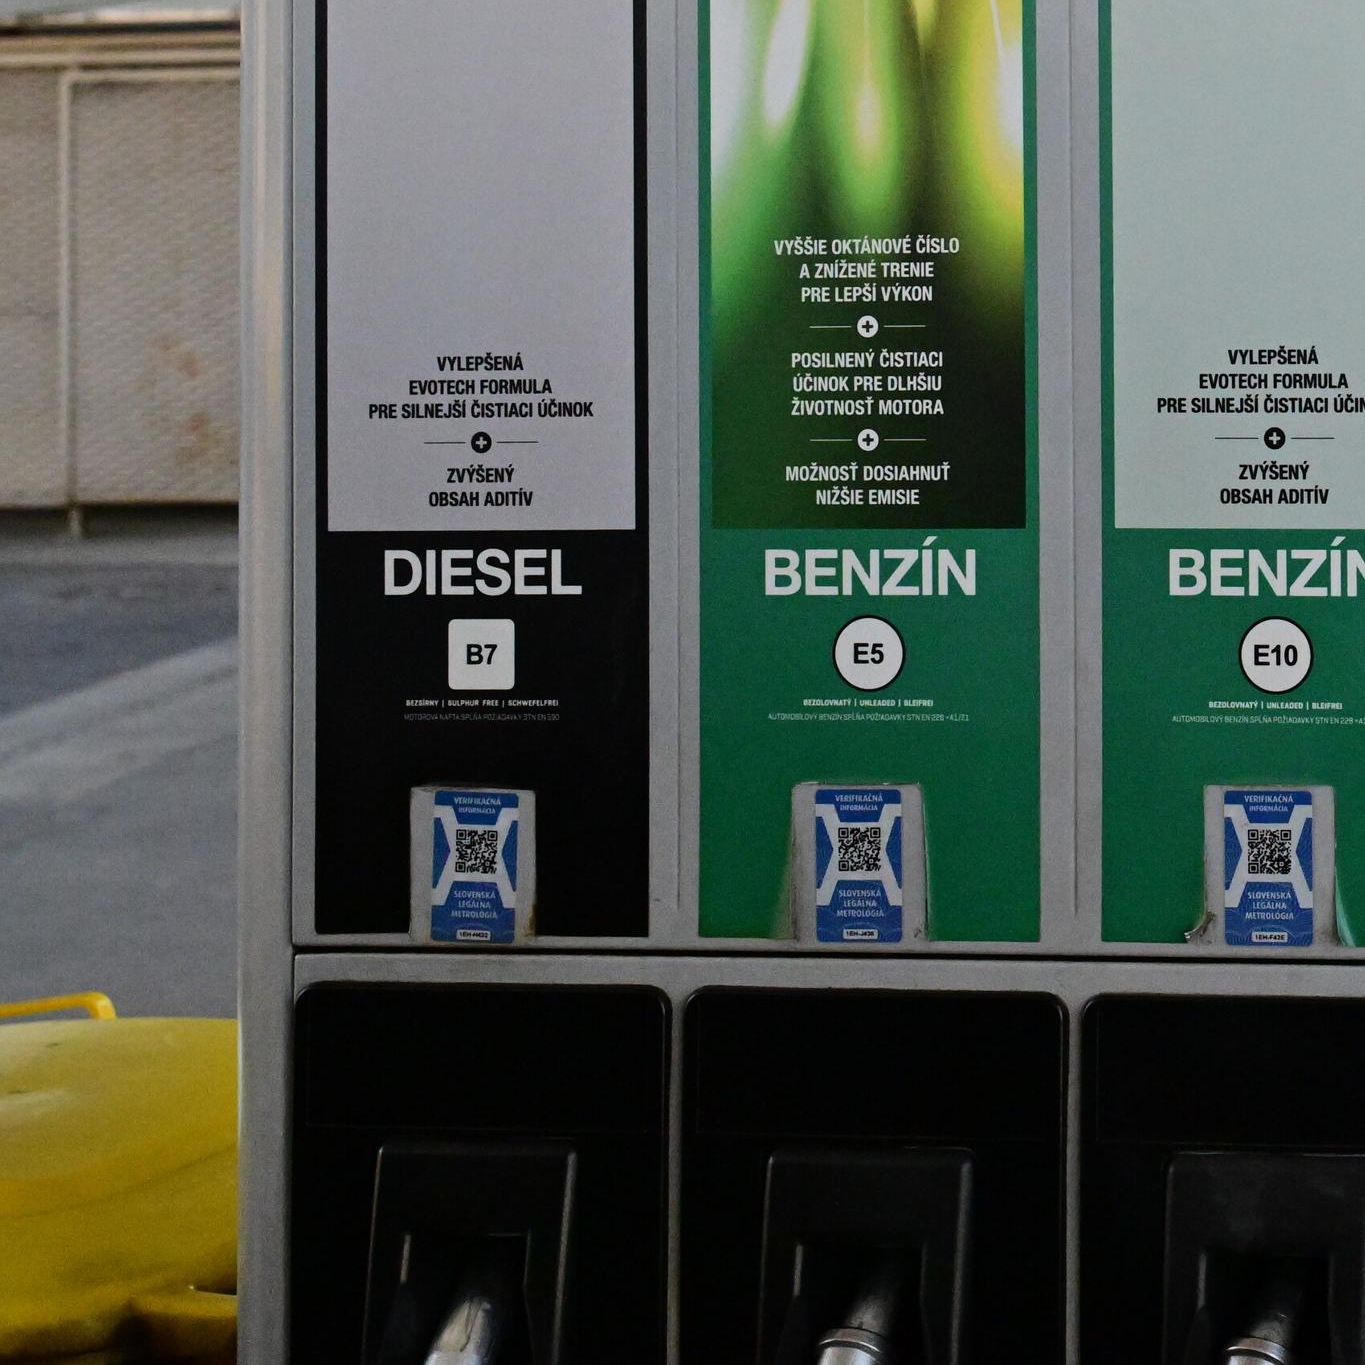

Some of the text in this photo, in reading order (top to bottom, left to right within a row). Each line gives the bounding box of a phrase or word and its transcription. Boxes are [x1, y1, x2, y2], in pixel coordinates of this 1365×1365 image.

[773, 234, 959, 255] VYŠŠIE OKTÁNOVÉ ČÍSLO
[799, 258, 933, 278] A ZNÍŽENÉ TRENIE
[801, 282, 932, 302] PRE LEPŠÍ VÝKON
[436, 351, 523, 371] VYLEPŠENÁ
[791, 348, 942, 367] POSILNENÝ ČISTIACI
[409, 378, 552, 395] EVOTECH FORMULA
[792, 372, 941, 391] ÚČINOK PRE DLHŠIU
[369, 398, 593, 418] PRE SILNEJŠÍ ČISTIACI ÚČINOK
[791, 396, 943, 415] ŽIVOTNOSŤ MOTORA
[446, 463, 514, 483] ZVÝŠENÝ
[785, 461, 950, 481] MOŽNOSŤ DOSIAHNUŤ
[428, 487, 533, 506] OBSAH ADITÍV
[816, 485, 919, 504] NIŽŠIE EMISIE
[384, 548, 582, 595] DIESEL
[765, 537, 976, 596] BENZÍN
[465, 643, 498, 665] B7
[853, 643, 884, 664] E5
[1254, 645, 1298, 667] E10
